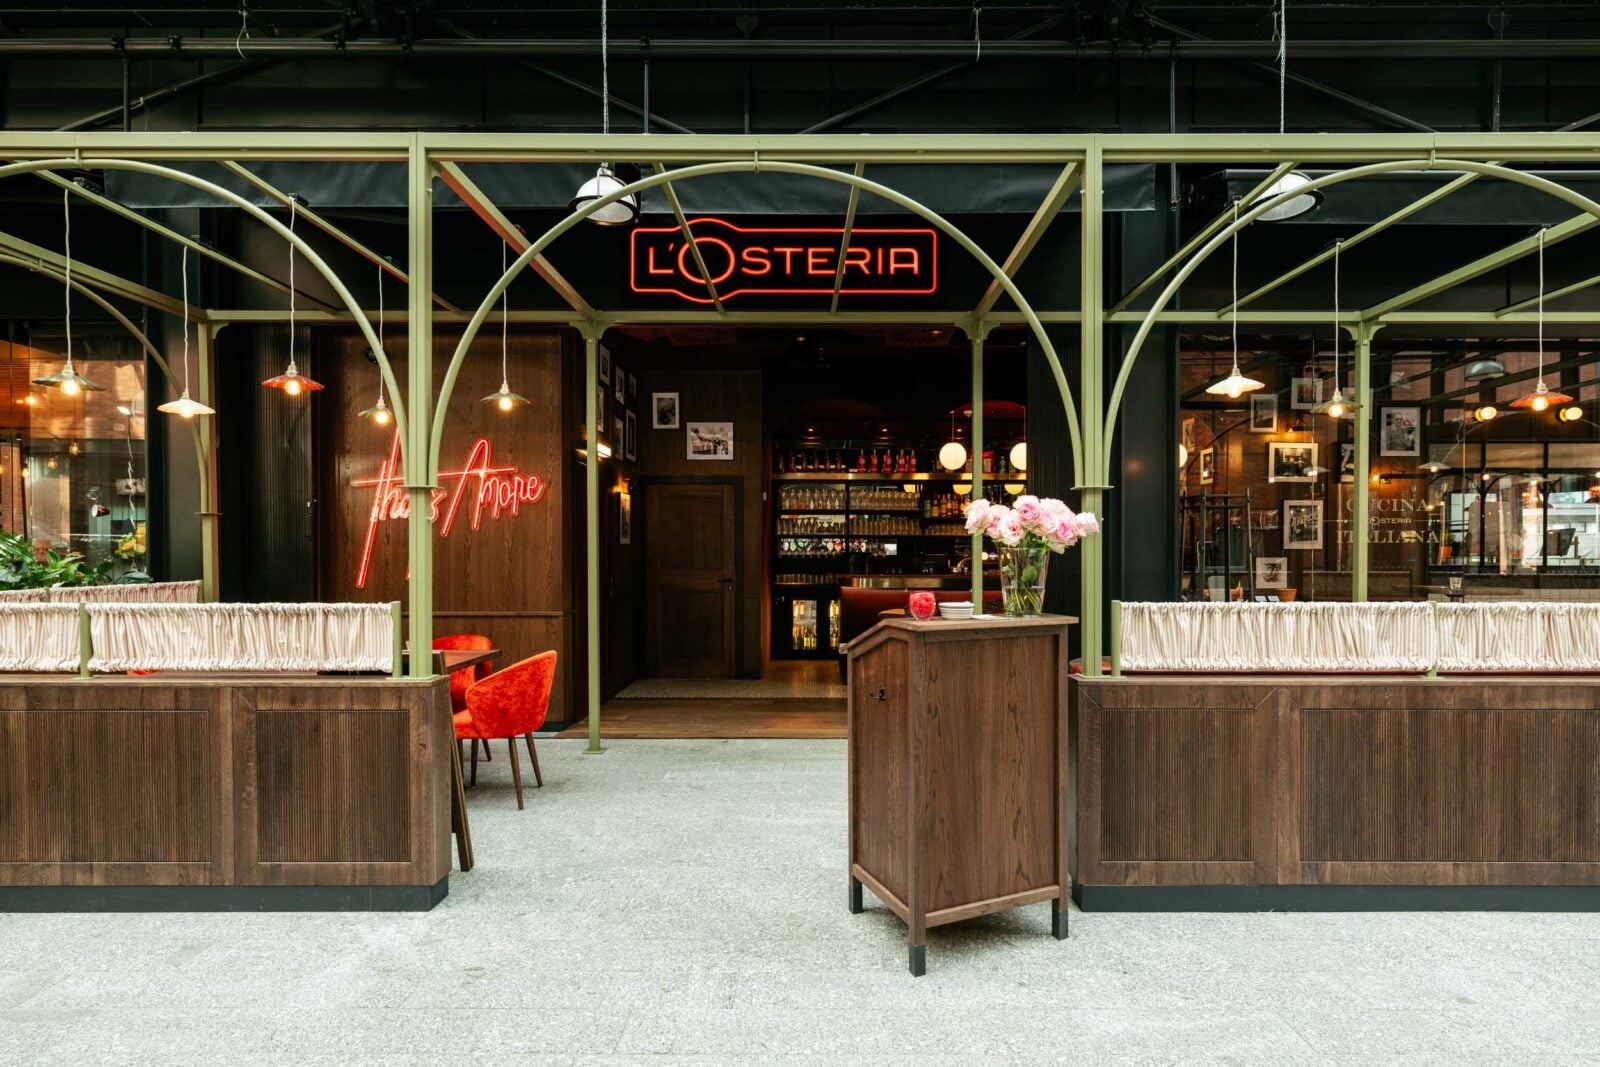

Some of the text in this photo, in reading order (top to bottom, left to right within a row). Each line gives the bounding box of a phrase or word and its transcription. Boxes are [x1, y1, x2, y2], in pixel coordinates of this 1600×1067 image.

[648, 237, 919, 284] L'OSTERIA
[438, 438, 545, 536] Amore
[1336, 531, 1440, 543] ITLIANA
